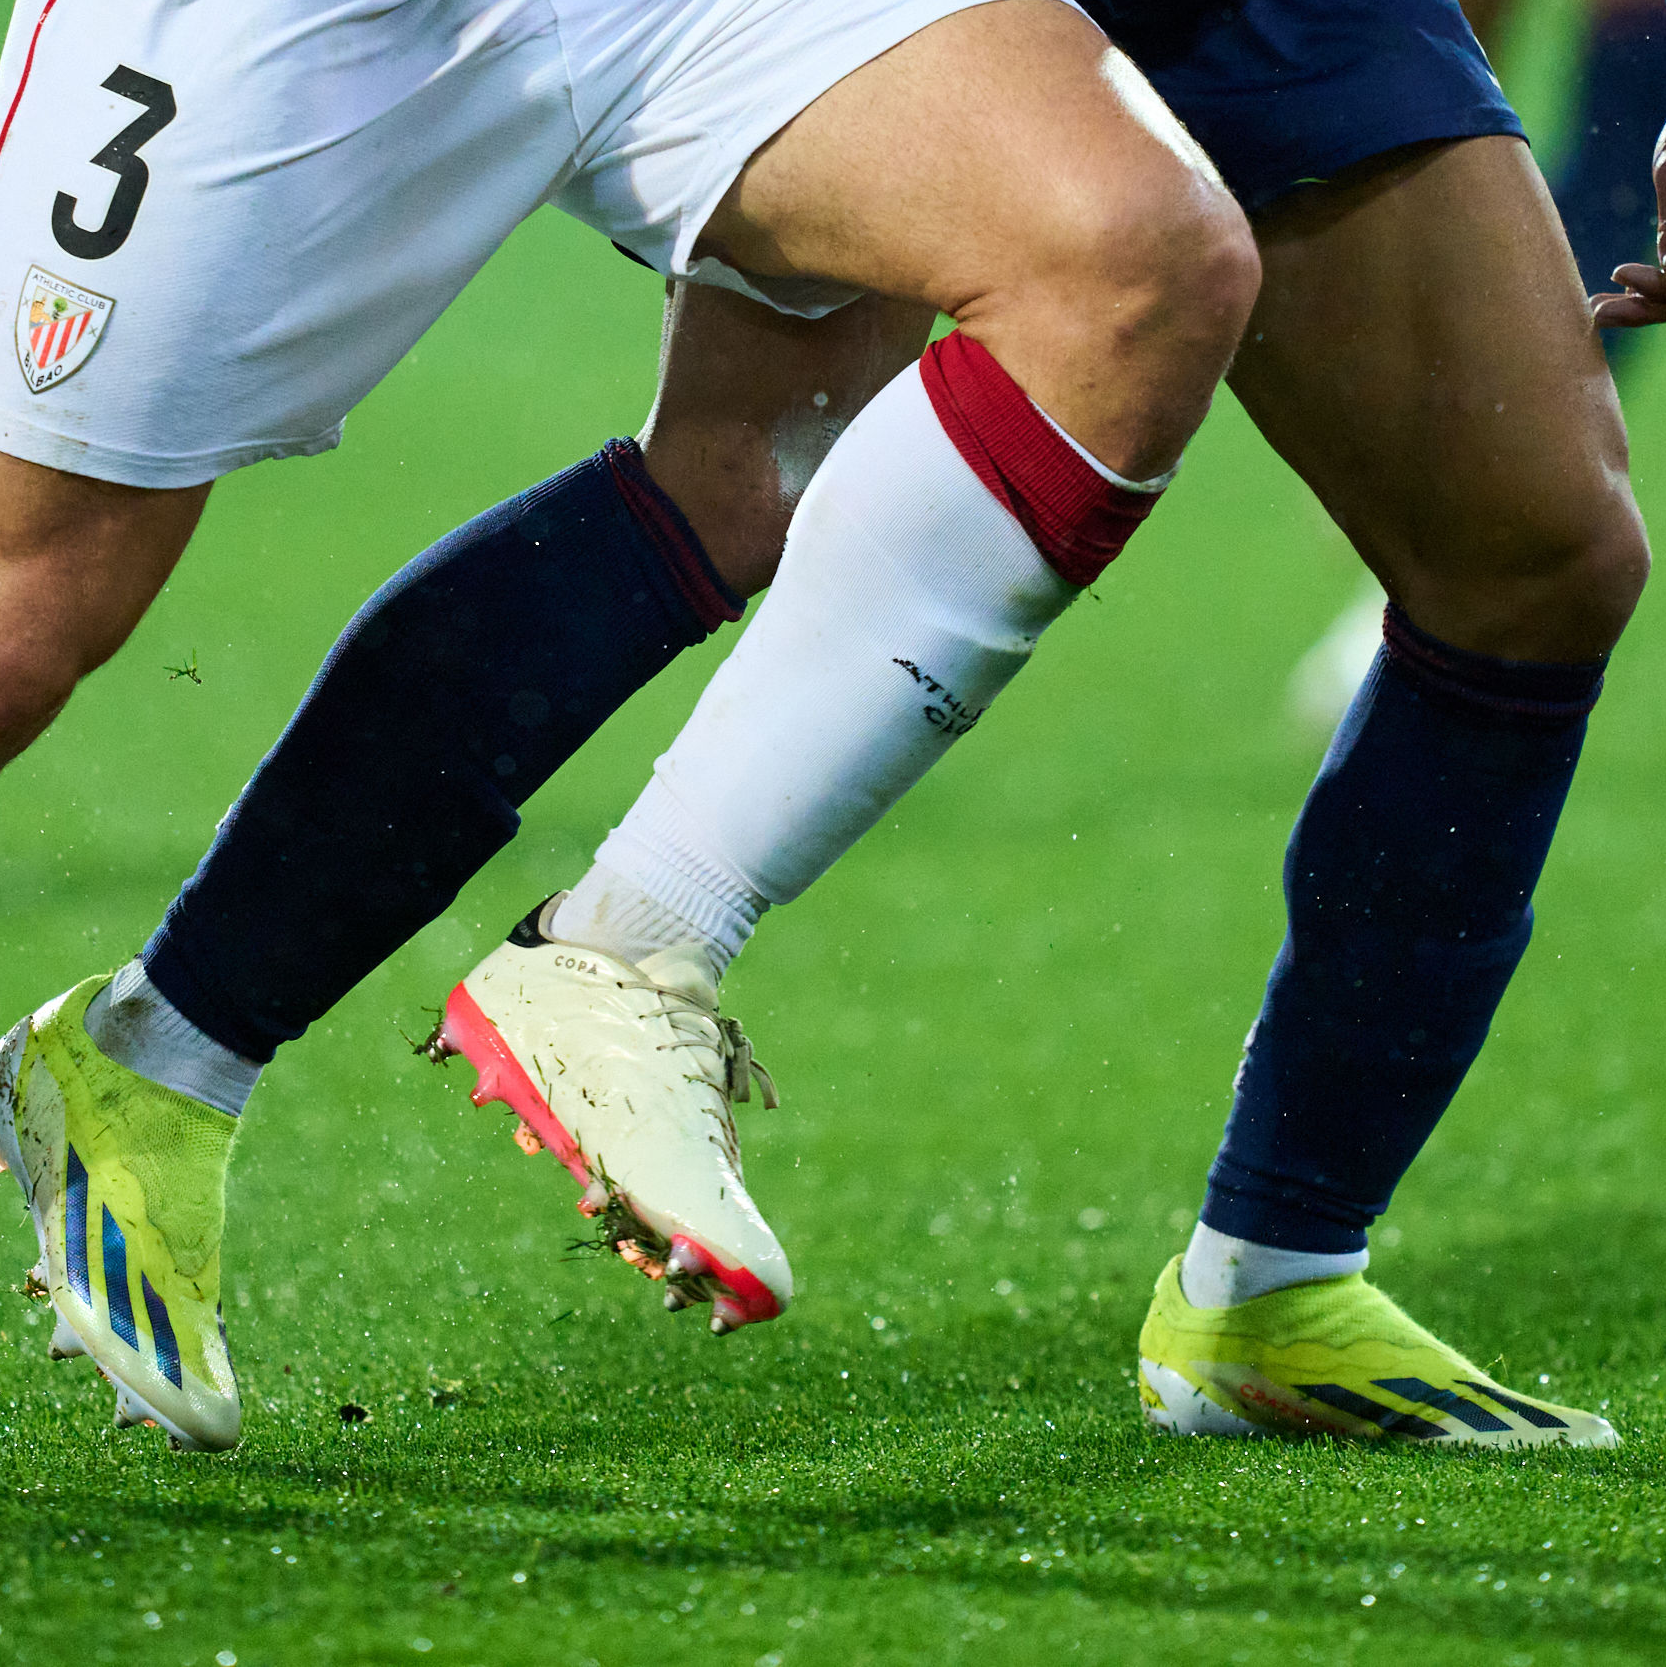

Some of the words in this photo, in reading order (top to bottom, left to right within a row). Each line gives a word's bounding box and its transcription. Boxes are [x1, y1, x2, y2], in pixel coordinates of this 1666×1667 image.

[51, 64, 177, 260] 3
[32, 273, 76, 298] ATHLETIC
[77, 293, 106, 310] CLUB
[23, 350, 63, 388] BILBAO
[554, 955, 598, 975] COPA
